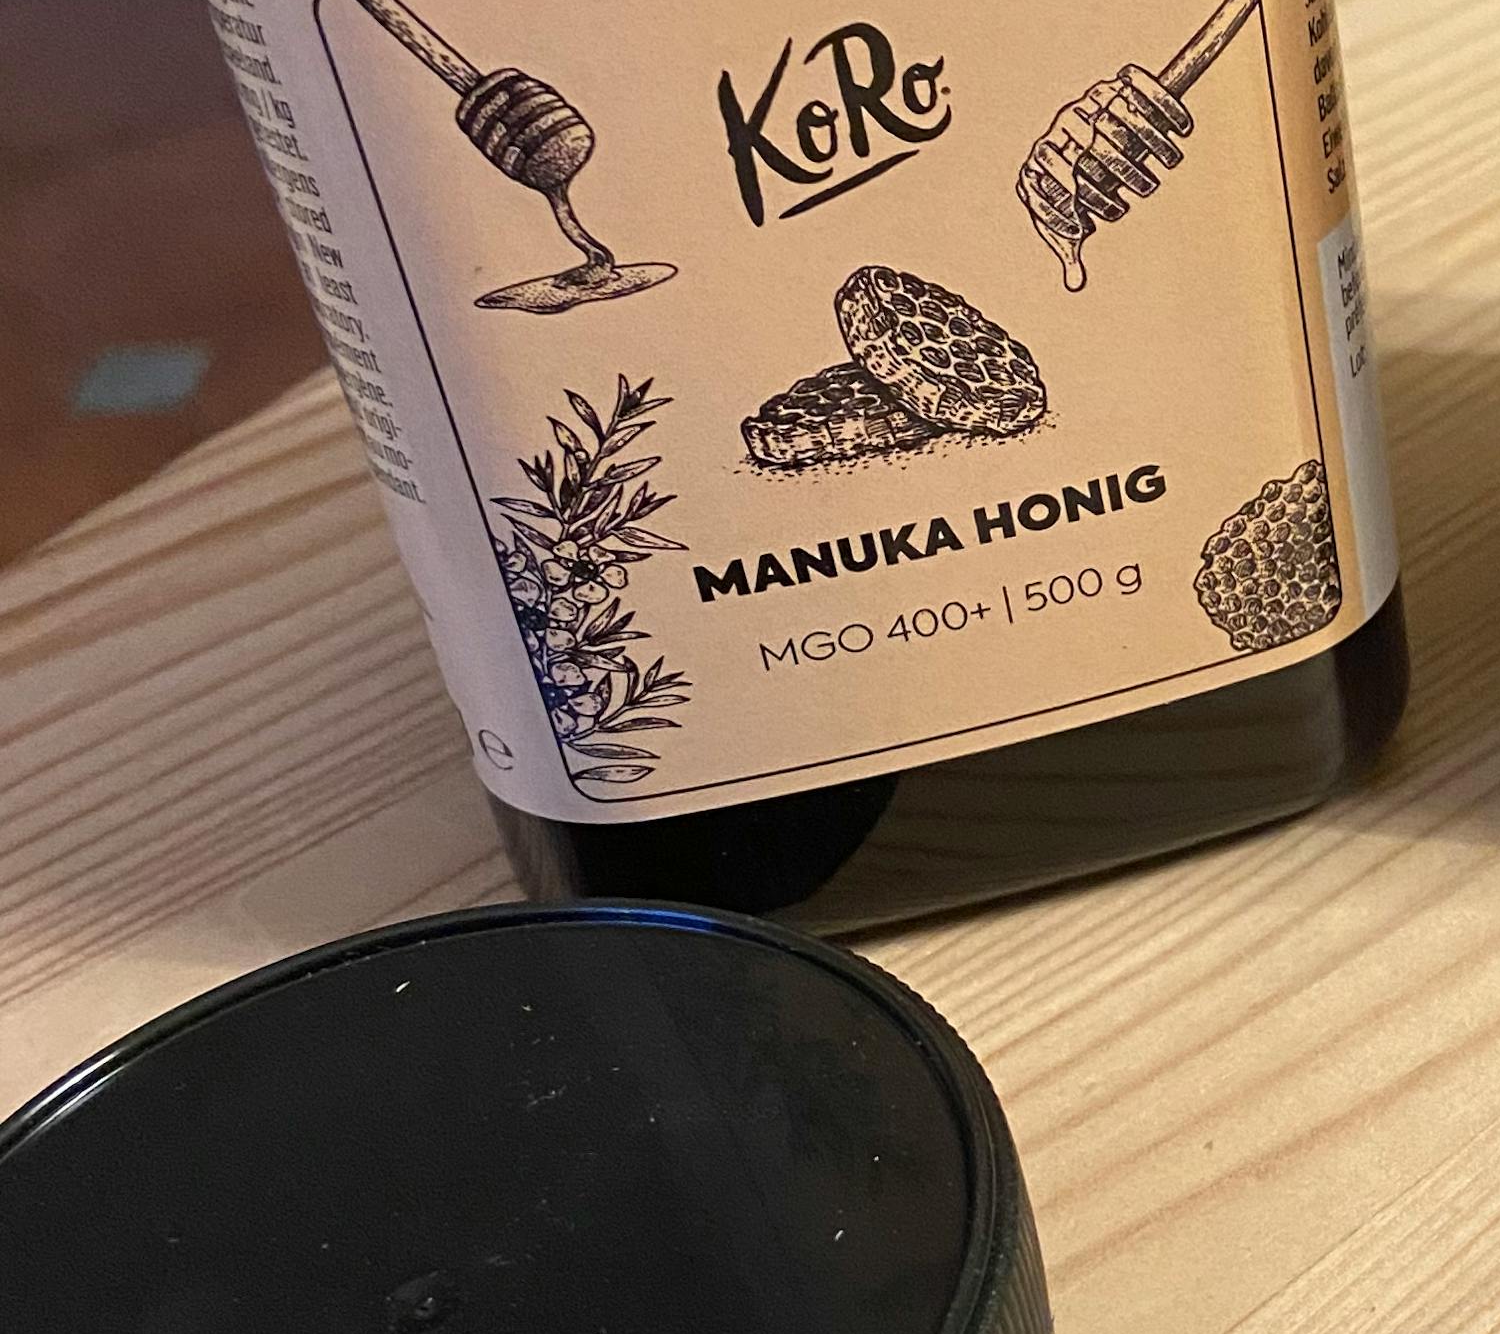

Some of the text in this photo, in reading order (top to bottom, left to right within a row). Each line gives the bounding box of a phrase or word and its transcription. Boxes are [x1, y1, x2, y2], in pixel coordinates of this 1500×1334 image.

[269, 91, 296, 129] kg
[717, 21, 953, 228] KoRo
[307, 234, 343, 269] New
[693, 464, 1167, 603] MANUKA HONIG
[759, 623, 874, 672] MGO
[887, 600, 992, 643] 400+
[1025, 567, 1103, 612] 500
[1115, 562, 1143, 595] g
